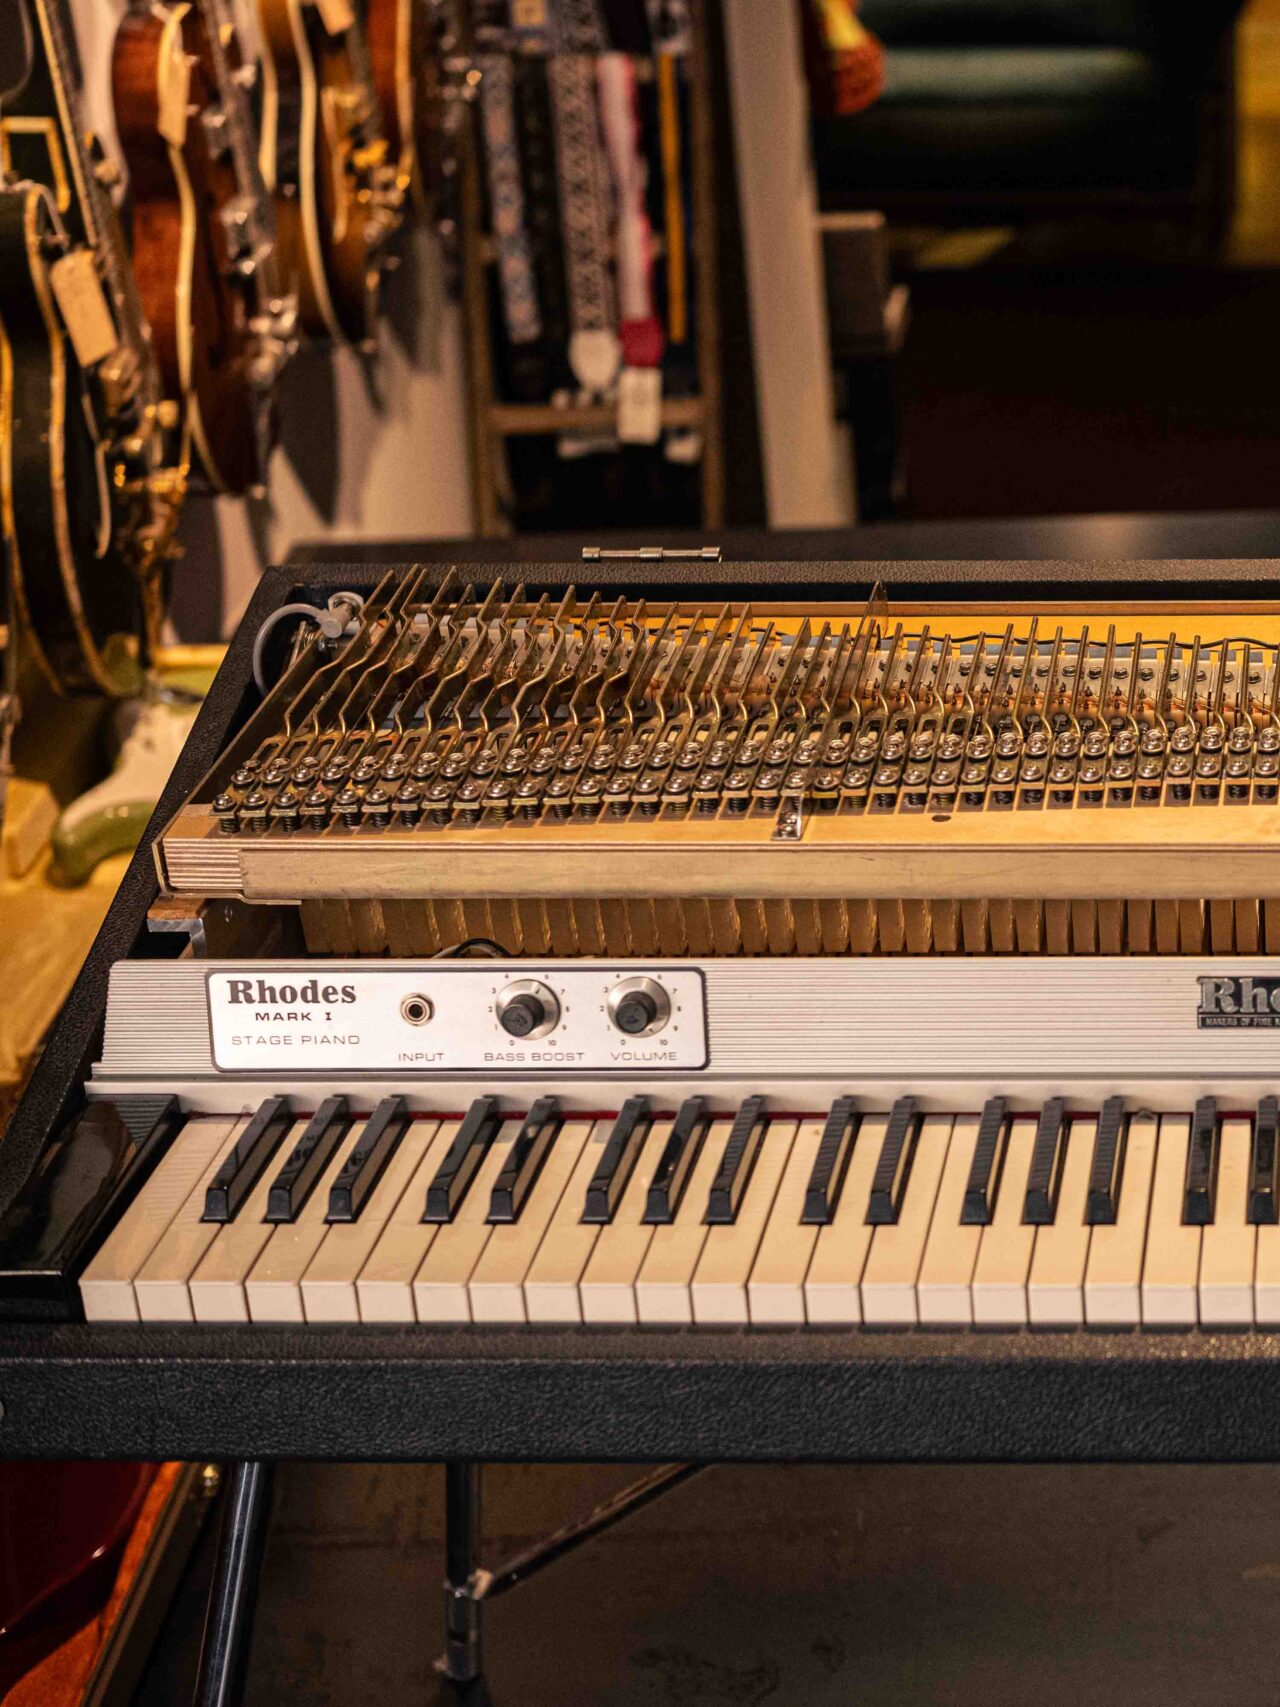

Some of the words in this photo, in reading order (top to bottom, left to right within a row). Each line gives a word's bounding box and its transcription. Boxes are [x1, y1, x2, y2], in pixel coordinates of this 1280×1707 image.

[227, 979, 357, 1004] Rhodes
[255, 1012, 312, 1021] MARK
[325, 1012, 333, 1021] I
[231, 1035, 293, 1045] STAGE
[301, 1035, 360, 1045] PIANO
[398, 1052, 445, 1062] INPUT
[484, 1052, 525, 1062] BASS
[532, 1052, 585, 1062] BOOST
[610, 1052, 678, 1061] VOLUME
